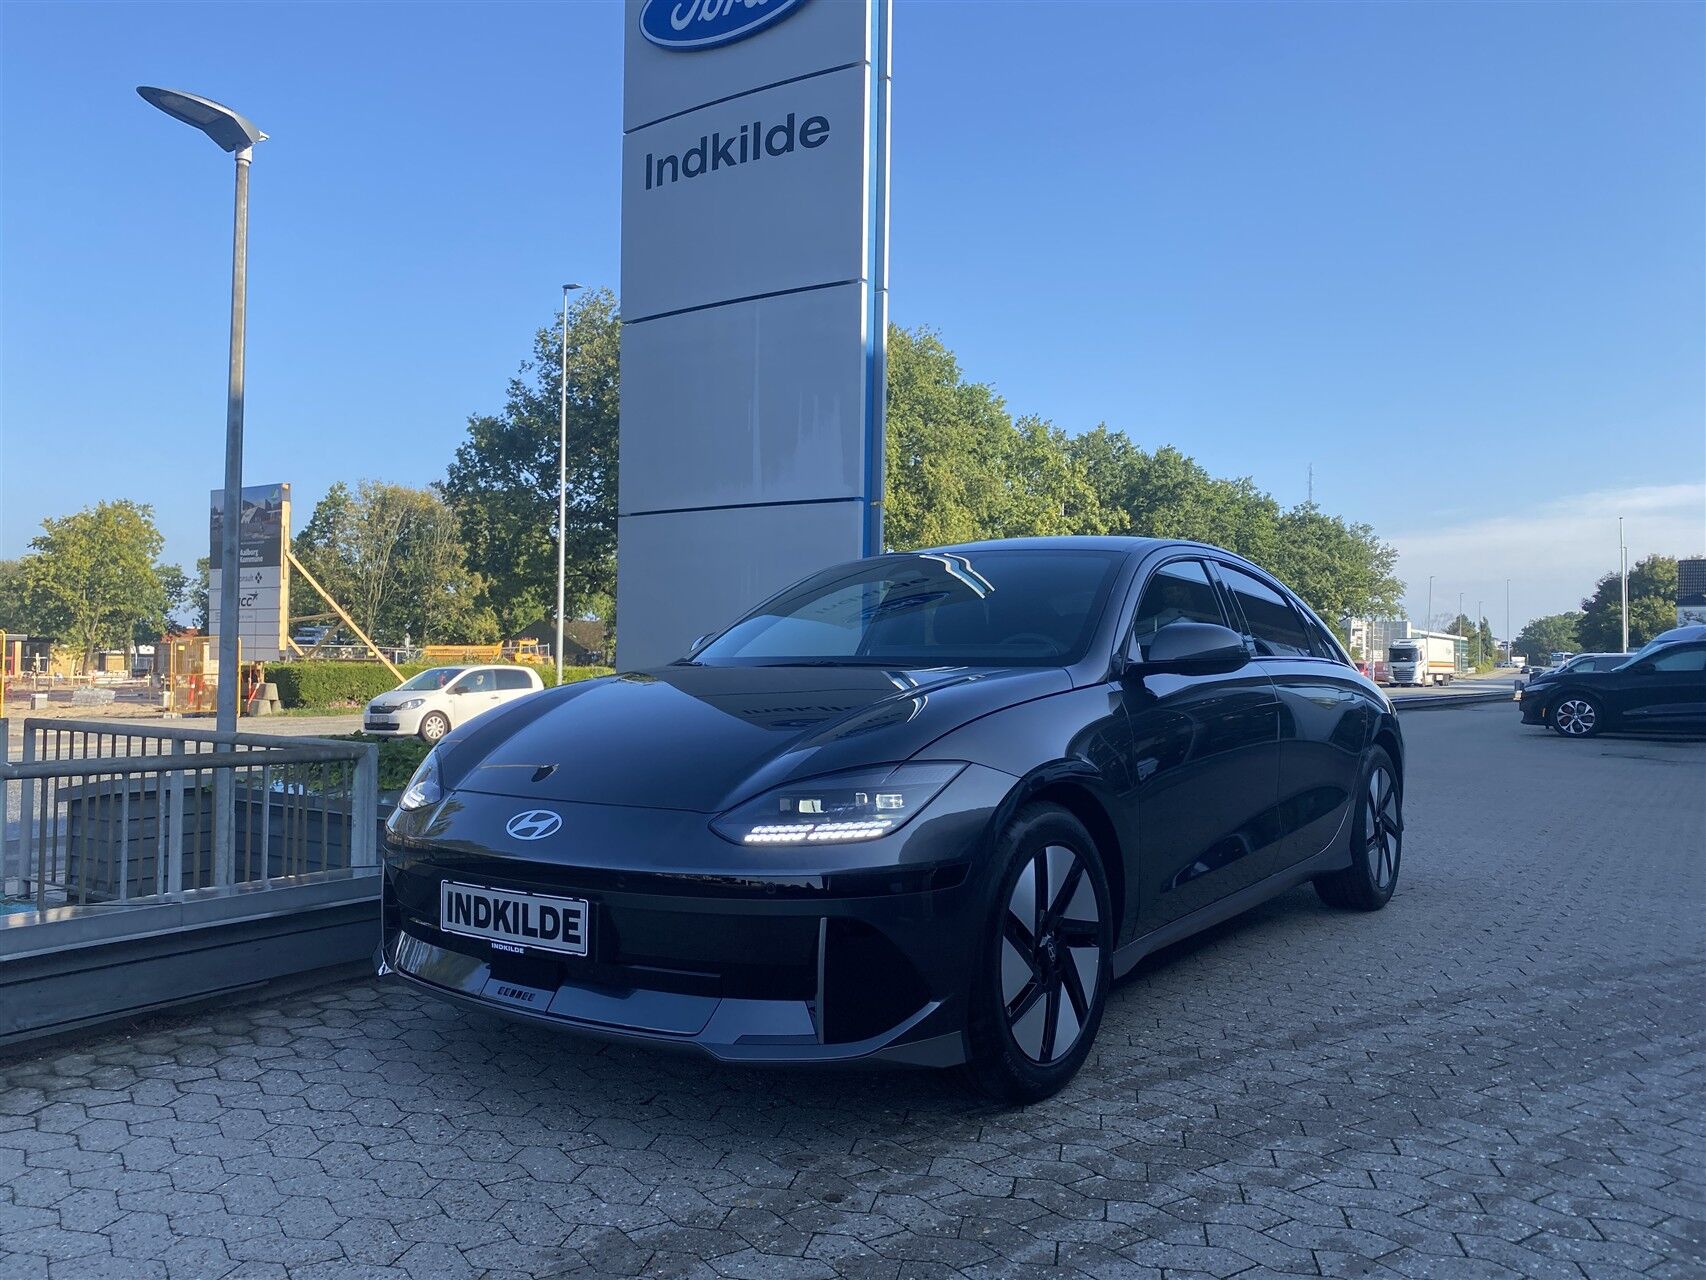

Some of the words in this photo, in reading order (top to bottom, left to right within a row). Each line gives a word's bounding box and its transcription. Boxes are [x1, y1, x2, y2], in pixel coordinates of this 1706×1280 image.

[645, 112, 831, 191] Indkilde
[446, 890, 582, 945] INDKILDE
[491, 942, 525, 954] INDKILDE
